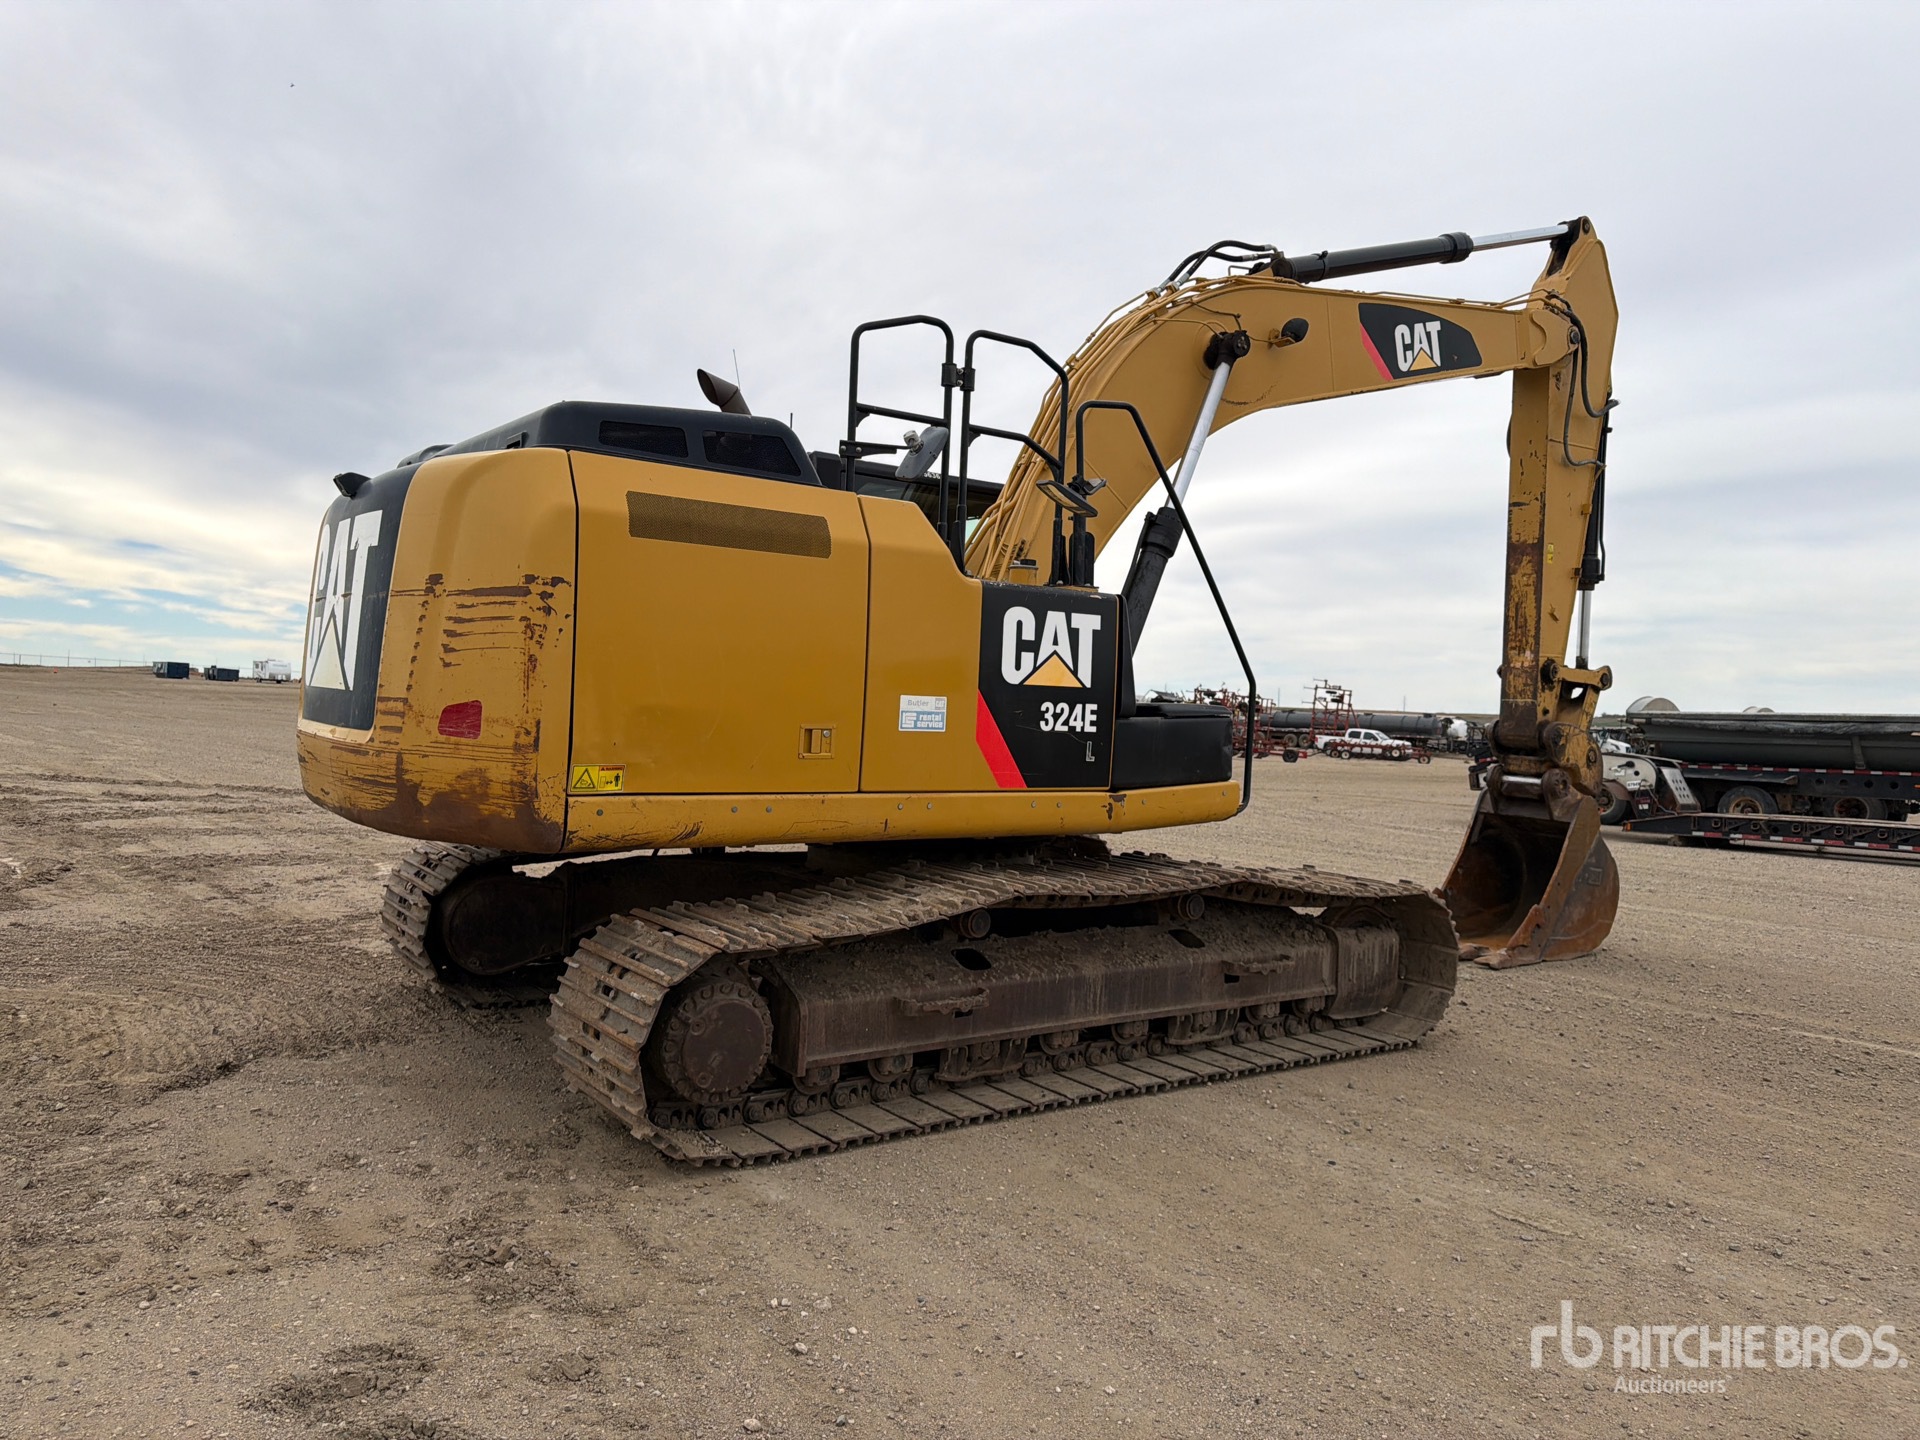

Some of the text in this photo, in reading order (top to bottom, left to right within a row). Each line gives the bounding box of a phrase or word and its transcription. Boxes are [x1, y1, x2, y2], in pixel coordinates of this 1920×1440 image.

[1394, 320, 1442, 373] CAT
[305, 509, 384, 692] CAT
[1000, 605, 1102, 689] CAT
[916, 720, 943, 729] service
[919, 713, 942, 721] rental
[1039, 701, 1098, 733] 324E
[1085, 740, 1096, 763] L
